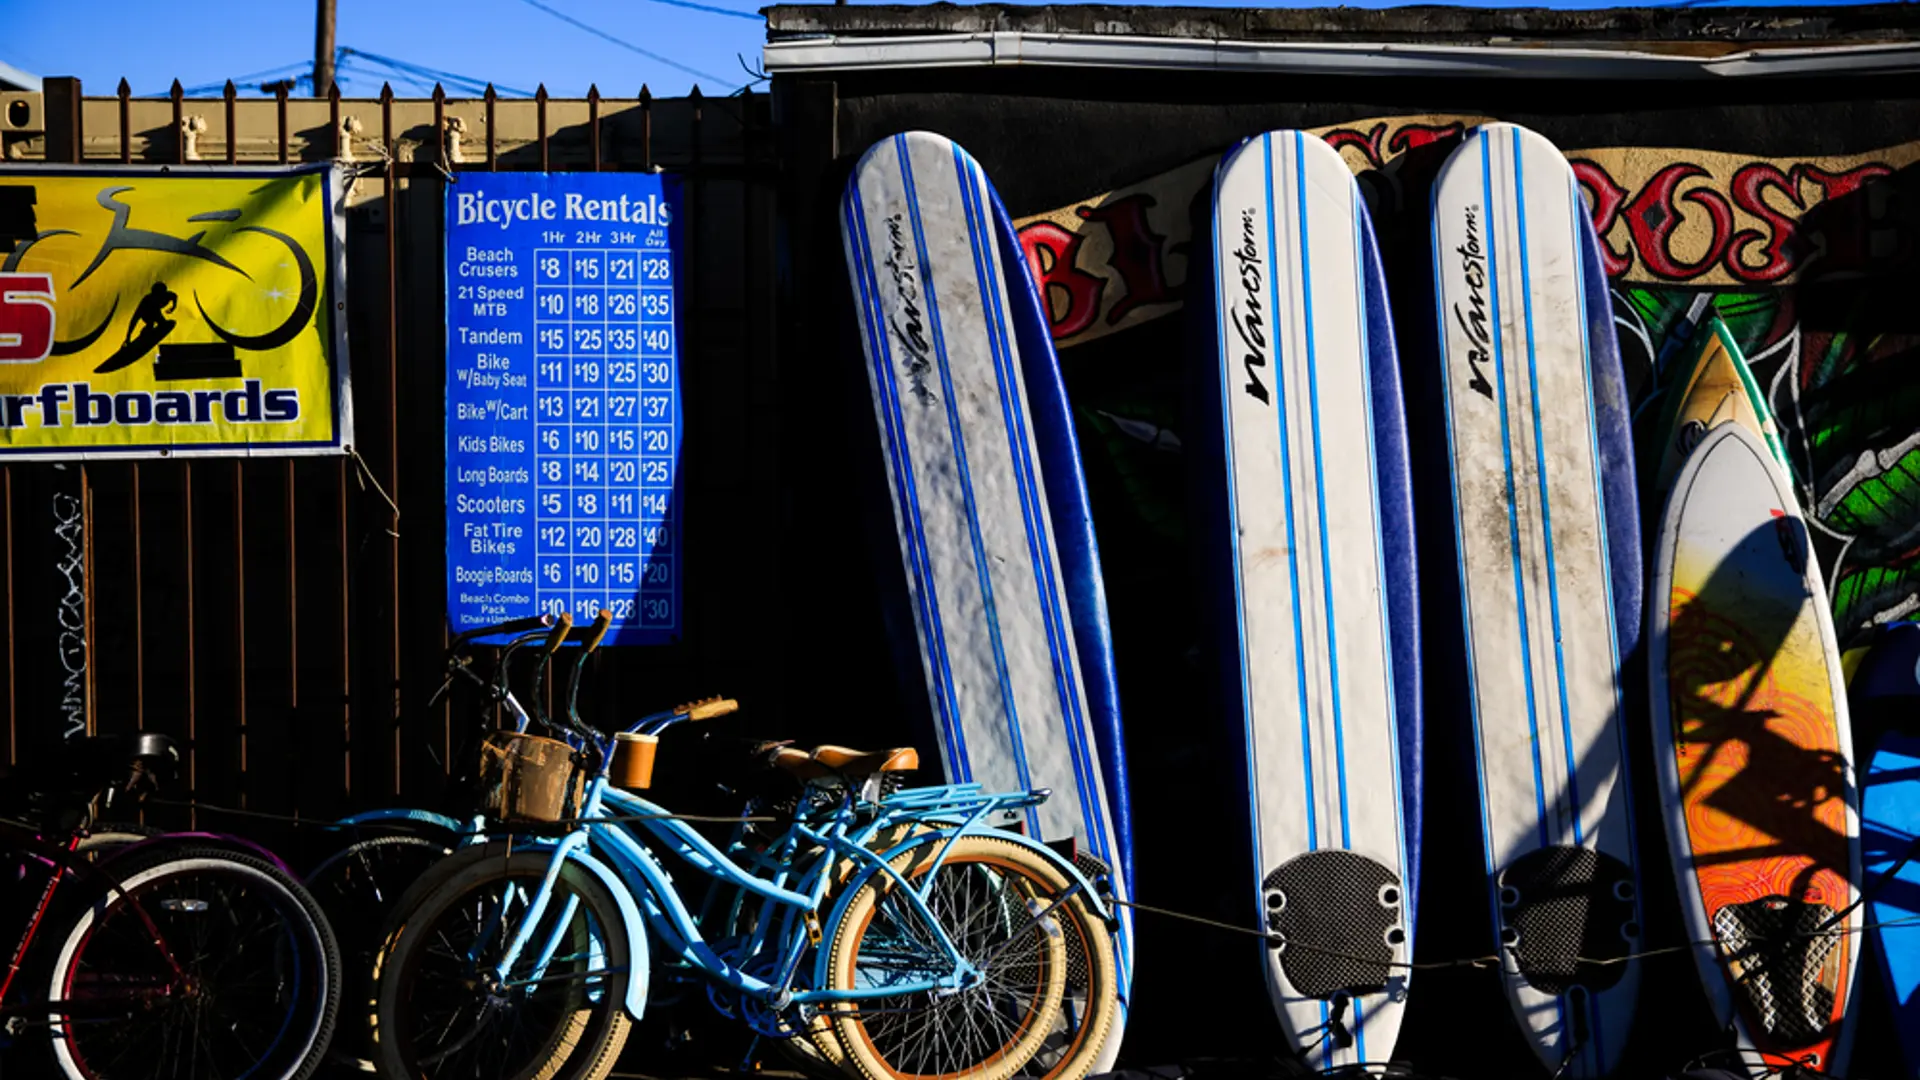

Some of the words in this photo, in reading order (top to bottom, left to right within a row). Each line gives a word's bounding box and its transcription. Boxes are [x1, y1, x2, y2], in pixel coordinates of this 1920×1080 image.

[458, 190, 556, 230] Bicycle
[565, 193, 669, 227] Rentals
[645, 237, 667, 247] Day
[649, 229, 663, 237] All
[467, 246, 514, 262] Beach
[459, 262, 518, 278] Crusers
[540, 257, 561, 279] $8
[575, 258, 599, 279] $15
[610, 259, 634, 280] $21
[642, 258, 670, 280] $28
[458, 285, 474, 299] 21
[477, 285, 524, 301] Speed
[473, 303, 507, 317] MTB
[540, 294, 564, 315] $10
[575, 294, 599, 315] $18
[608, 294, 636, 315] $26
[642, 294, 669, 316] $35
[458, 327, 523, 345] Tandem
[540, 329, 564, 350] $15
[574, 329, 602, 350] $25
[608, 329, 636, 350] $35
[643, 329, 669, 351] $40
[477, 353, 510, 370] Bike
[502, 372, 527, 387] Seat
[541, 362, 562, 382] $11
[574, 362, 600, 383] $19
[608, 362, 636, 383] $25
[643, 362, 669, 384] $30
[0, 380, 299, 428] rfboards
[458, 403, 486, 420] Bike
[539, 396, 563, 417] $13
[575, 396, 599, 417] $21
[608, 396, 636, 417] $27
[643, 396, 669, 417] $37
[458, 436, 487, 453] Kids
[490, 435, 525, 453] Bikes
[542, 429, 560, 451] $6
[575, 430, 599, 451] $10
[610, 430, 635, 451] $15
[643, 430, 669, 451] $20
[458, 467, 486, 487] Long
[489, 466, 529, 484] Boards
[542, 460, 562, 482] $8
[575, 461, 600, 482] $14
[610, 461, 635, 482] $20
[642, 461, 668, 482] $25
[456, 493, 526, 514] Scooters
[542, 493, 562, 514] $5
[577, 493, 598, 514] $8
[611, 493, 633, 514] $11
[643, 494, 667, 514] $14
[464, 522, 489, 538] Fat
[492, 522, 523, 538] Tire
[541, 526, 566, 547] $12
[576, 526, 602, 547] $20
[609, 526, 636, 548] $28
[642, 526, 669, 547] $40
[471, 538, 516, 555] Bikes
[456, 565, 494, 587] Boogie
[495, 566, 533, 584] Boards
[543, 562, 562, 583] $6
[575, 563, 599, 584] $10
[610, 562, 634, 583] $15
[642, 562, 669, 583] $20
[460, 593, 492, 603] Beach
[493, 593, 530, 604] Combo
[541, 598, 565, 619] $10
[576, 599, 600, 619] $16
[609, 599, 636, 619] $28
[644, 598, 669, 619] $30
[481, 605, 505, 614] Pack
